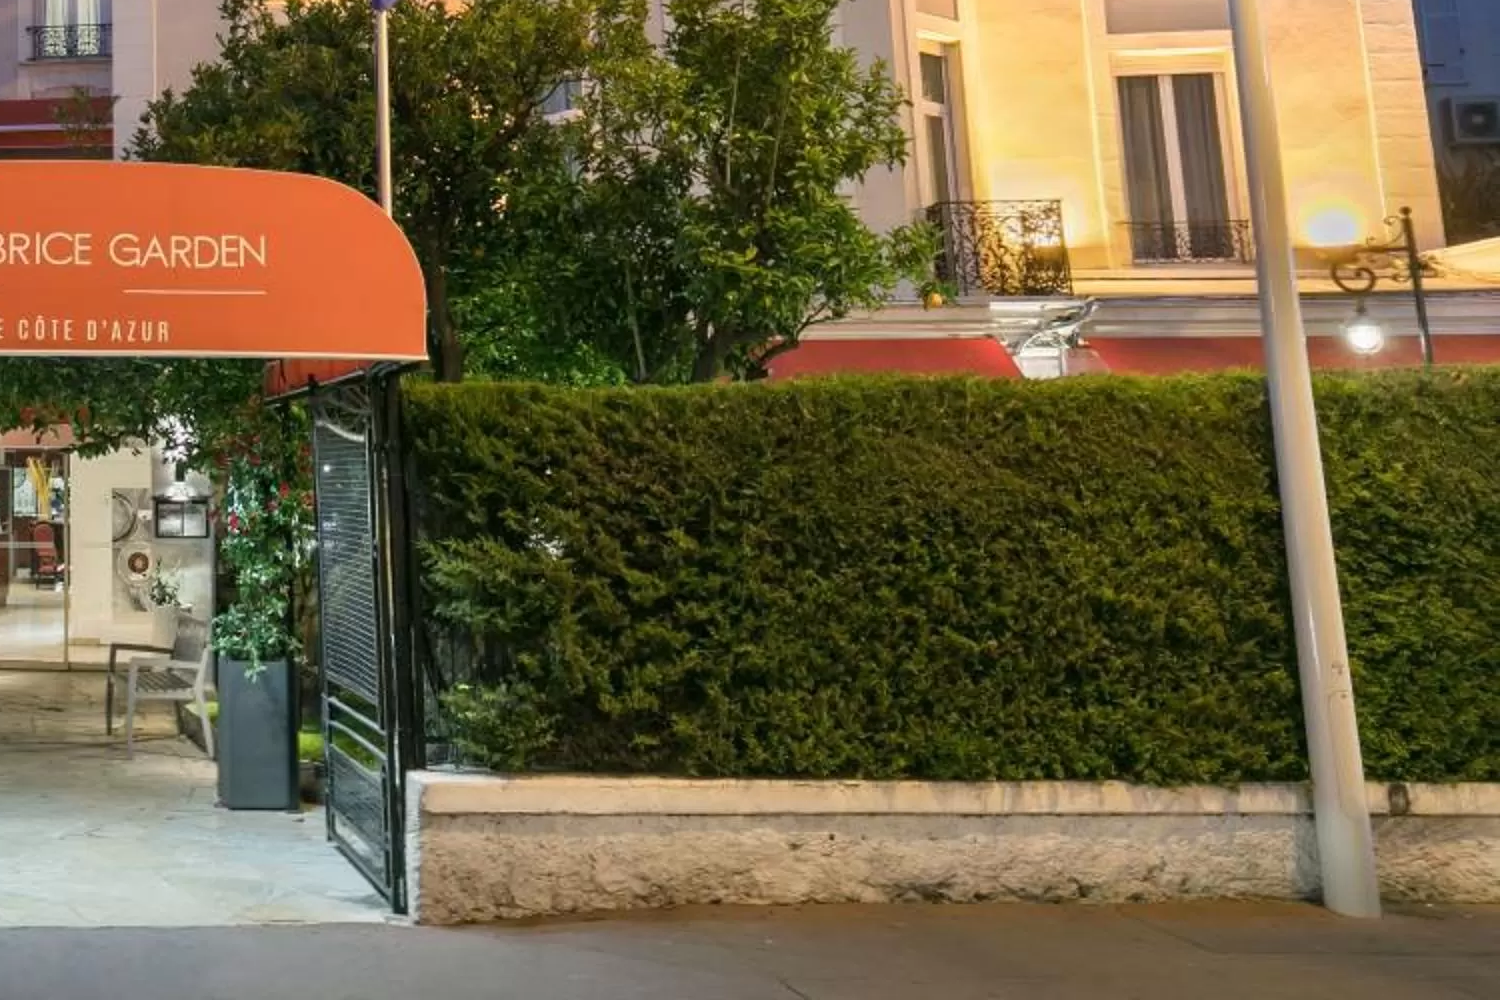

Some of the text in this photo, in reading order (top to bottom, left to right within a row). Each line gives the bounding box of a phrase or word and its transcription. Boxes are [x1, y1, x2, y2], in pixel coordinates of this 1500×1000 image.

[108, 233, 266, 269] GARDEN
[18, 314, 74, 341] CÔTE
[86, 319, 169, 343] D'AZUR
